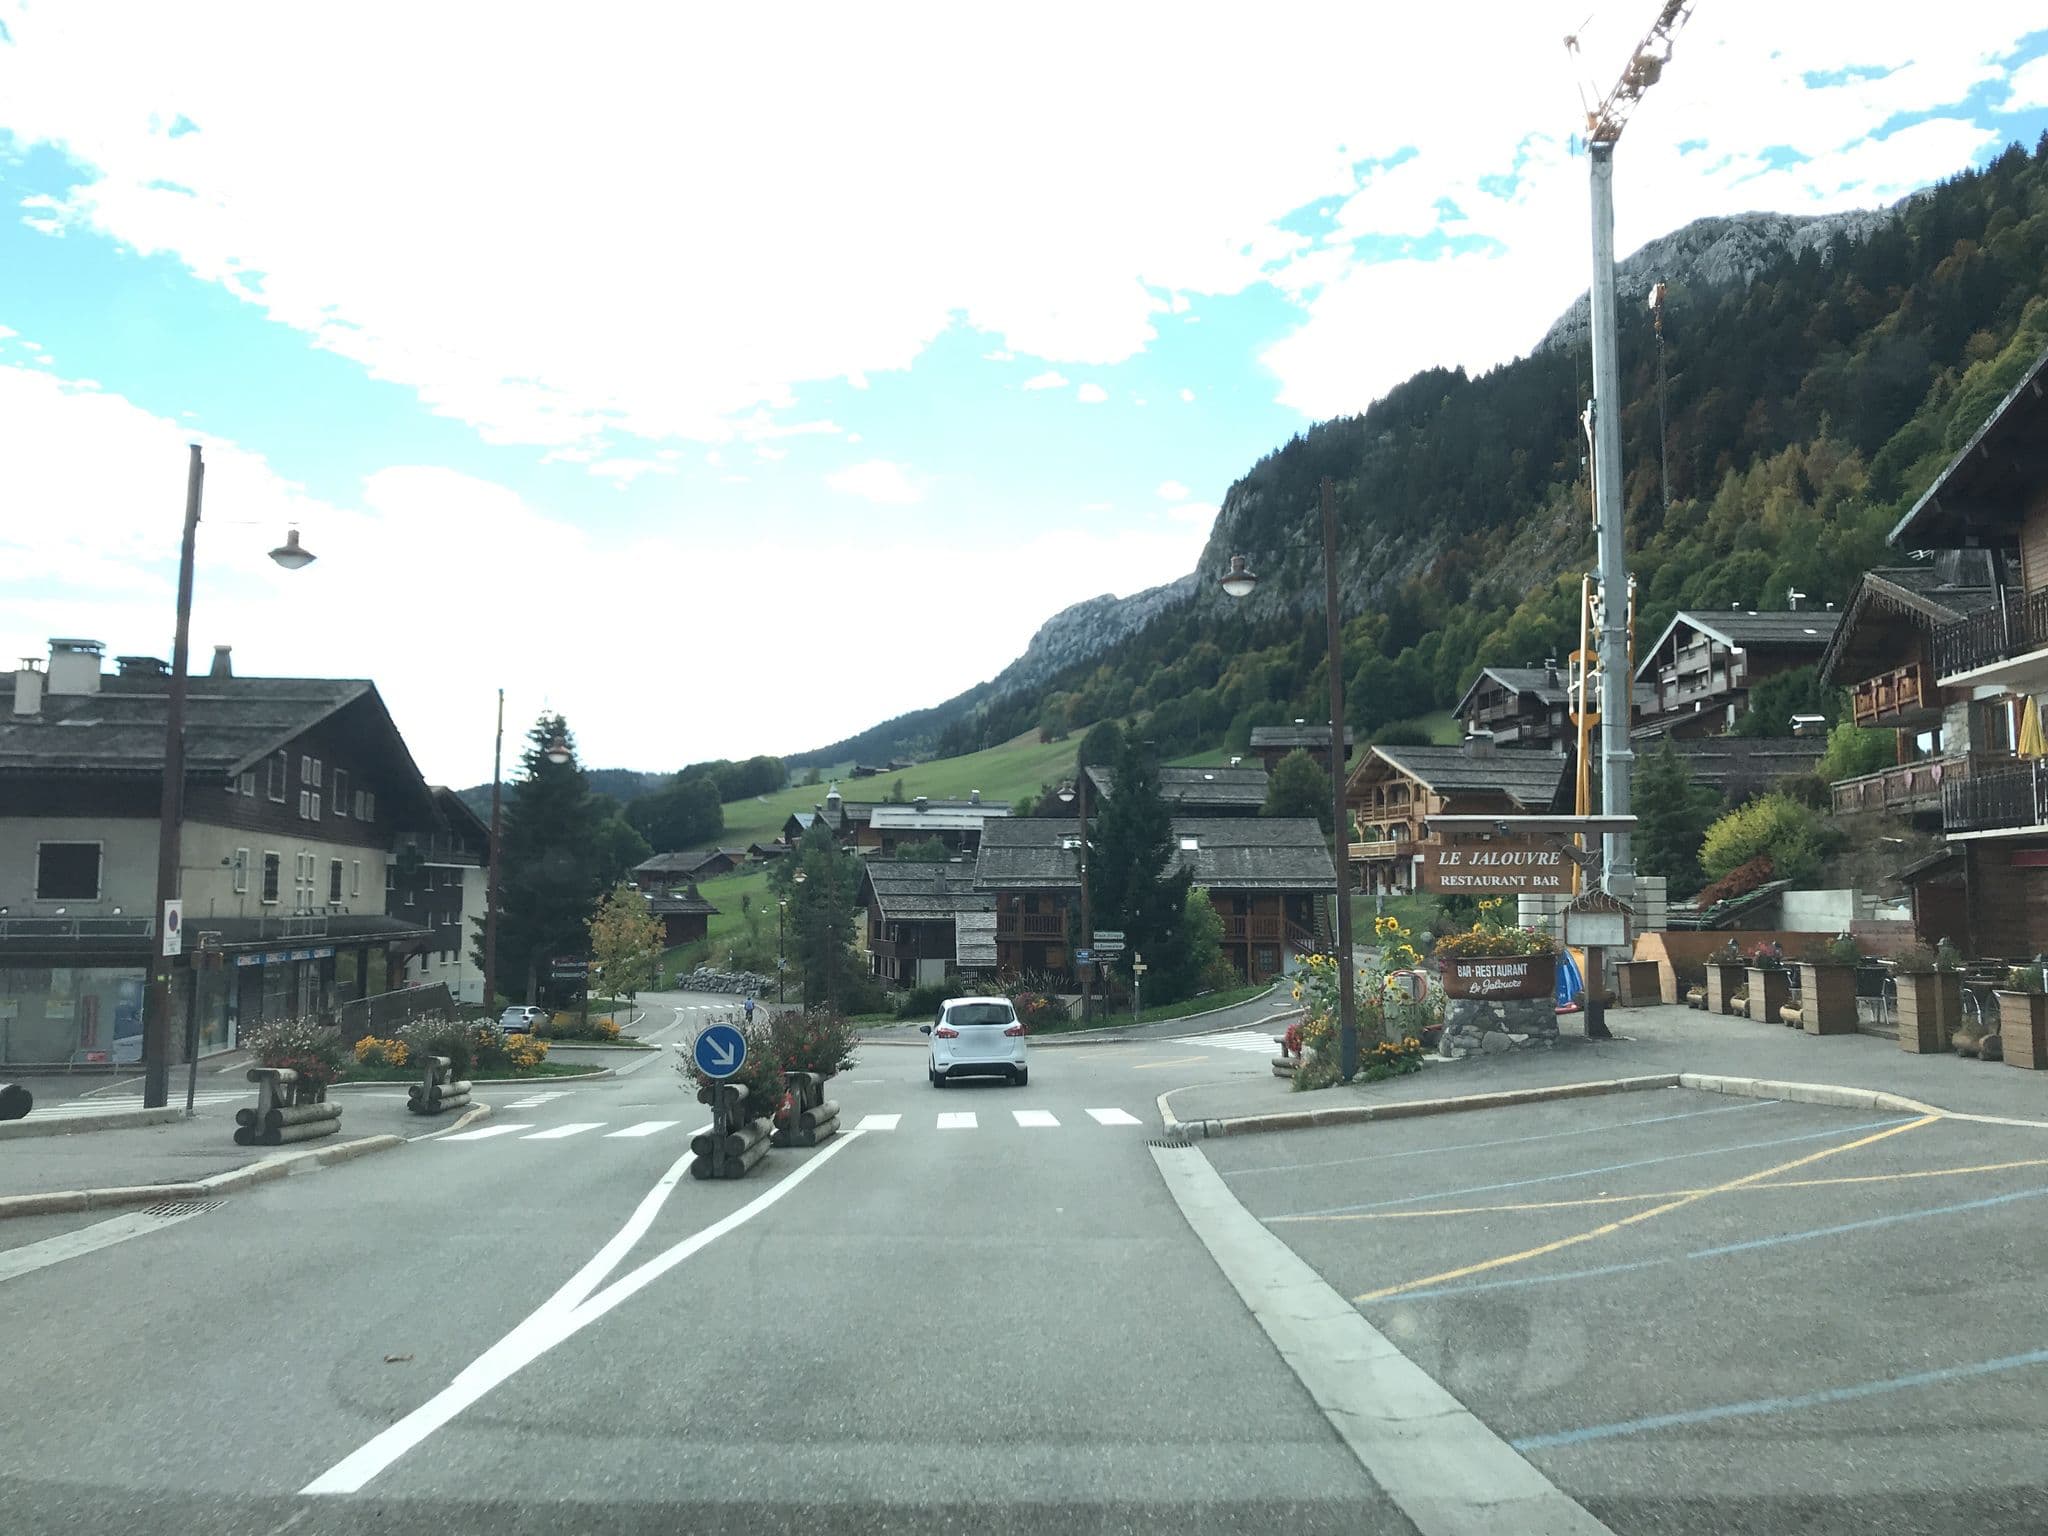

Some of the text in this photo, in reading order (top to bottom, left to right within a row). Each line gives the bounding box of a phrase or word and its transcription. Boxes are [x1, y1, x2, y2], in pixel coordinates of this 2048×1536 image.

[1439, 851, 1560, 865] LE JALOUVRE
[1440, 875, 1560, 886] RESTAURANT BAR
